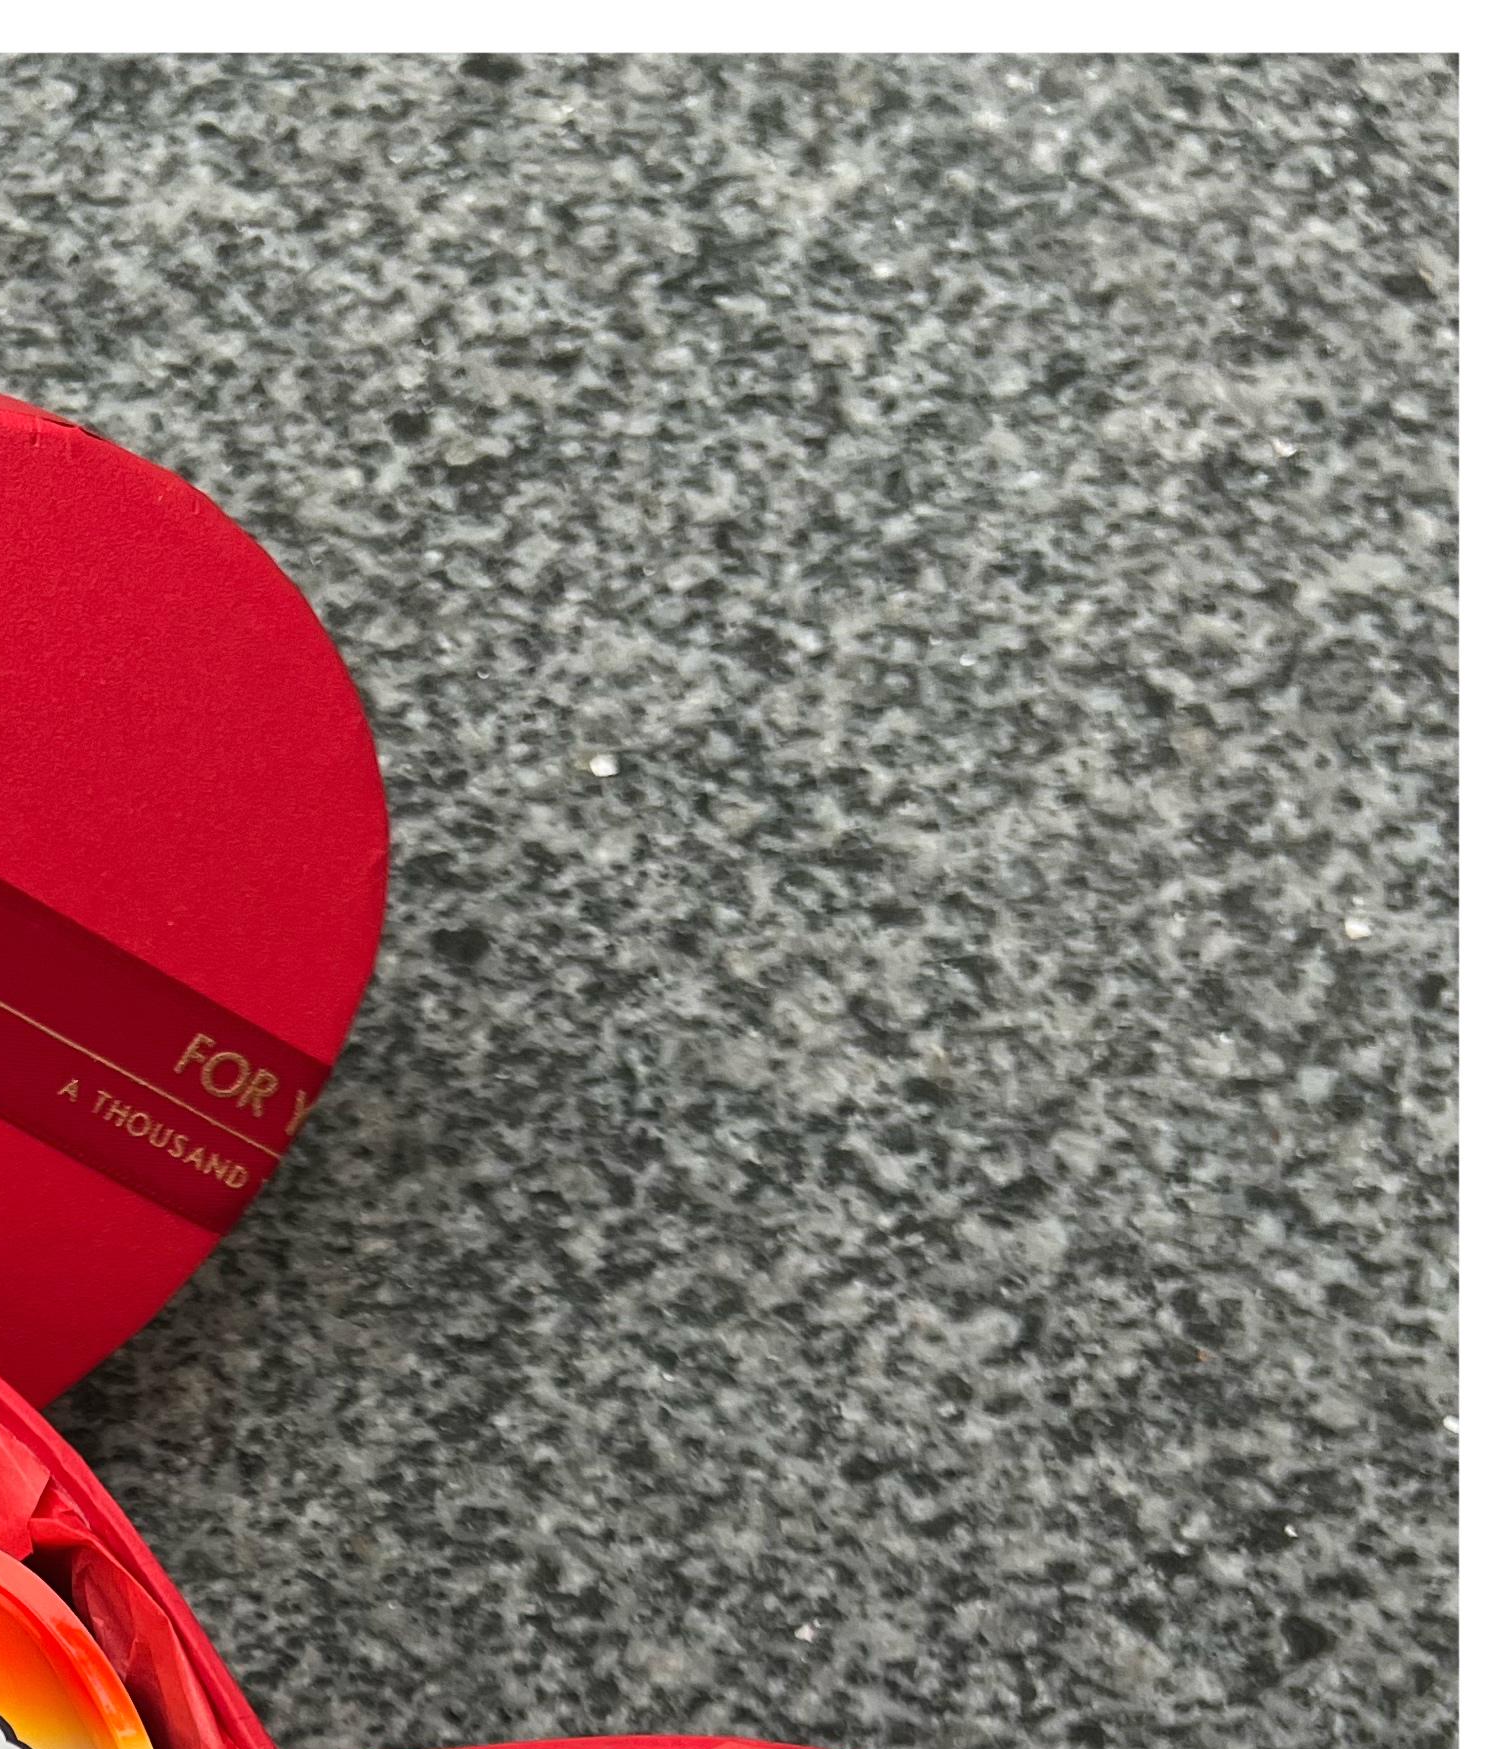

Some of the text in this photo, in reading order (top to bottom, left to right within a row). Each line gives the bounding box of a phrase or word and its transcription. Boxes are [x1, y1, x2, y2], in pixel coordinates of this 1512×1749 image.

[173, 1032, 280, 1118] FOR
[57, 1079, 250, 1189] A THOUSAND
